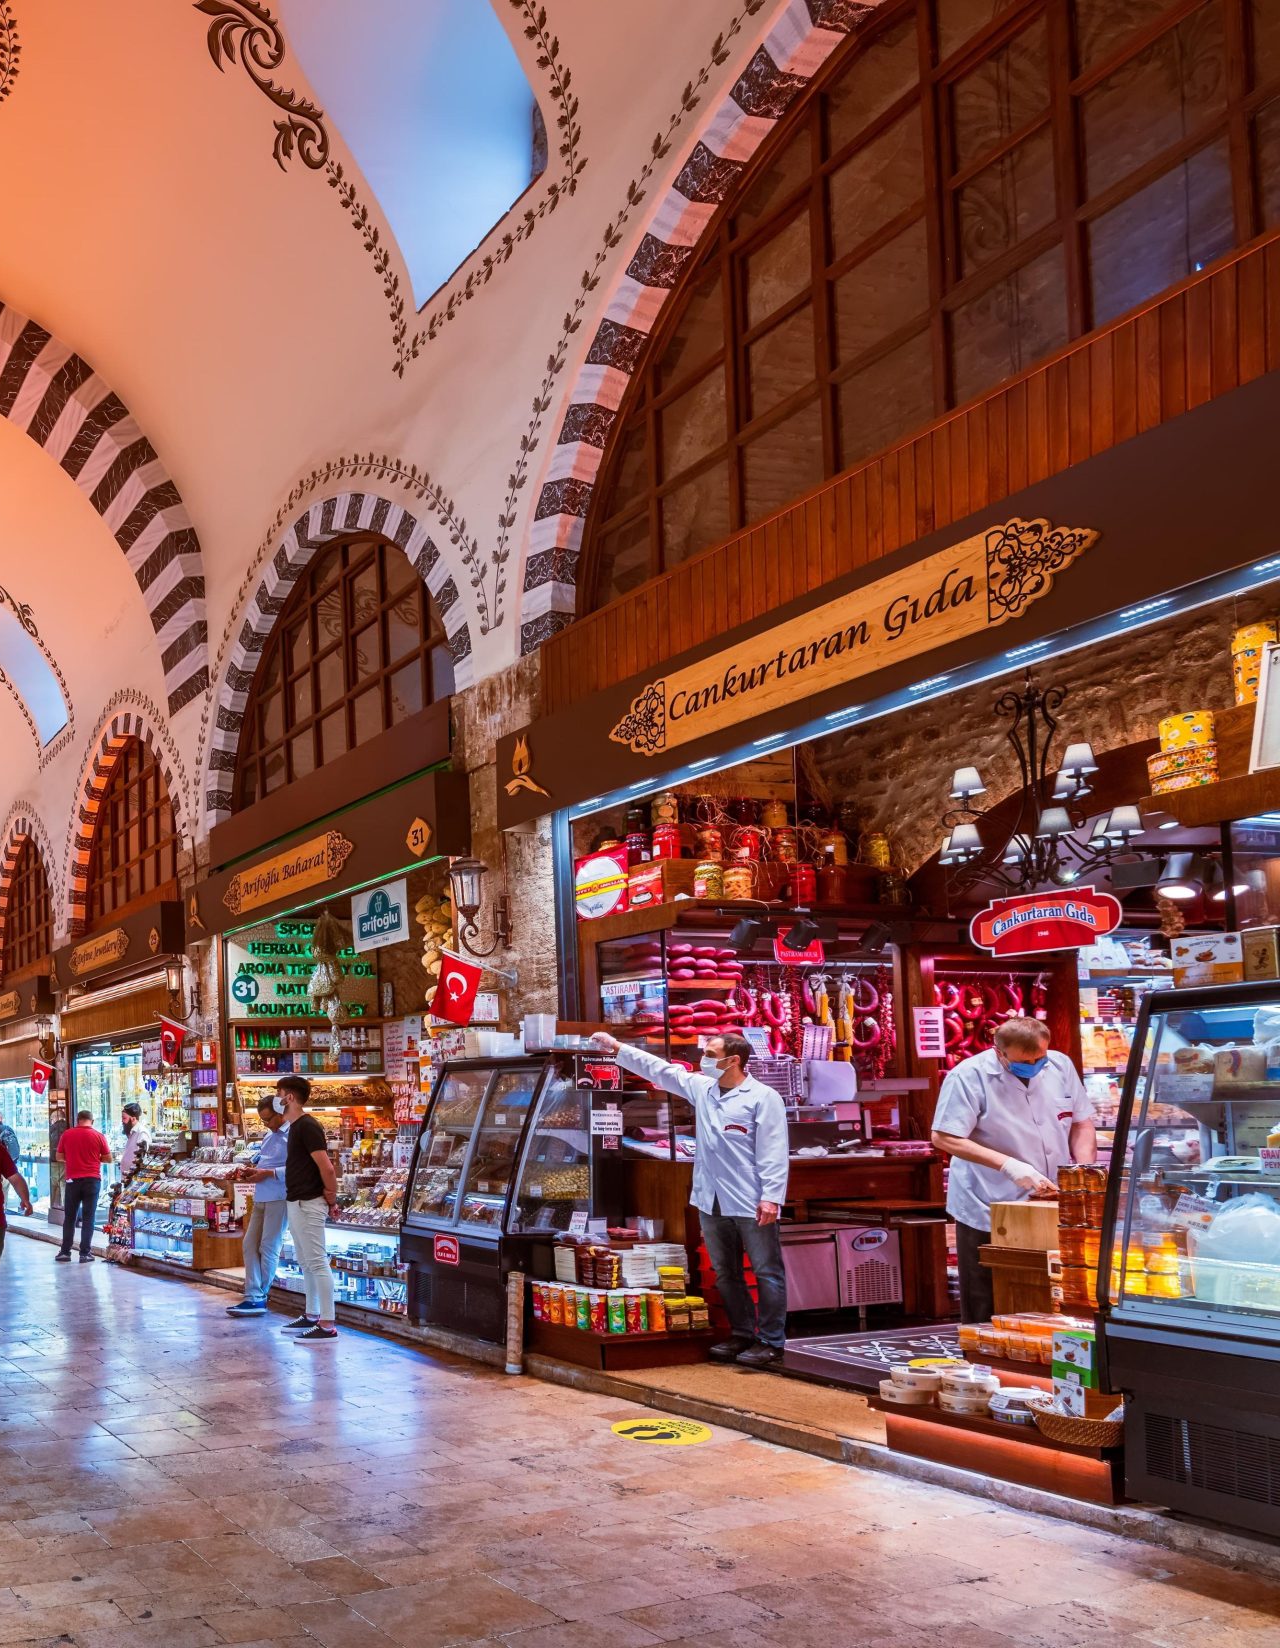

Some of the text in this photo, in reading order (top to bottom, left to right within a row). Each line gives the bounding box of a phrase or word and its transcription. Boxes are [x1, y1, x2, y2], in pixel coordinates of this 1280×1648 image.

[668, 567, 978, 723] Cankurtaran Gıda
[412, 828, 424, 847] 31
[241, 850, 325, 898] Arifoğlu Baharat
[361, 910, 398, 932] arifoğlu
[992, 903, 1095, 936] Cankurtaran Gıda
[251, 942, 306, 955] HERBAL
[237, 963, 285, 975] AROMA
[353, 963, 377, 976] OIL
[235, 981, 256, 997] 31
